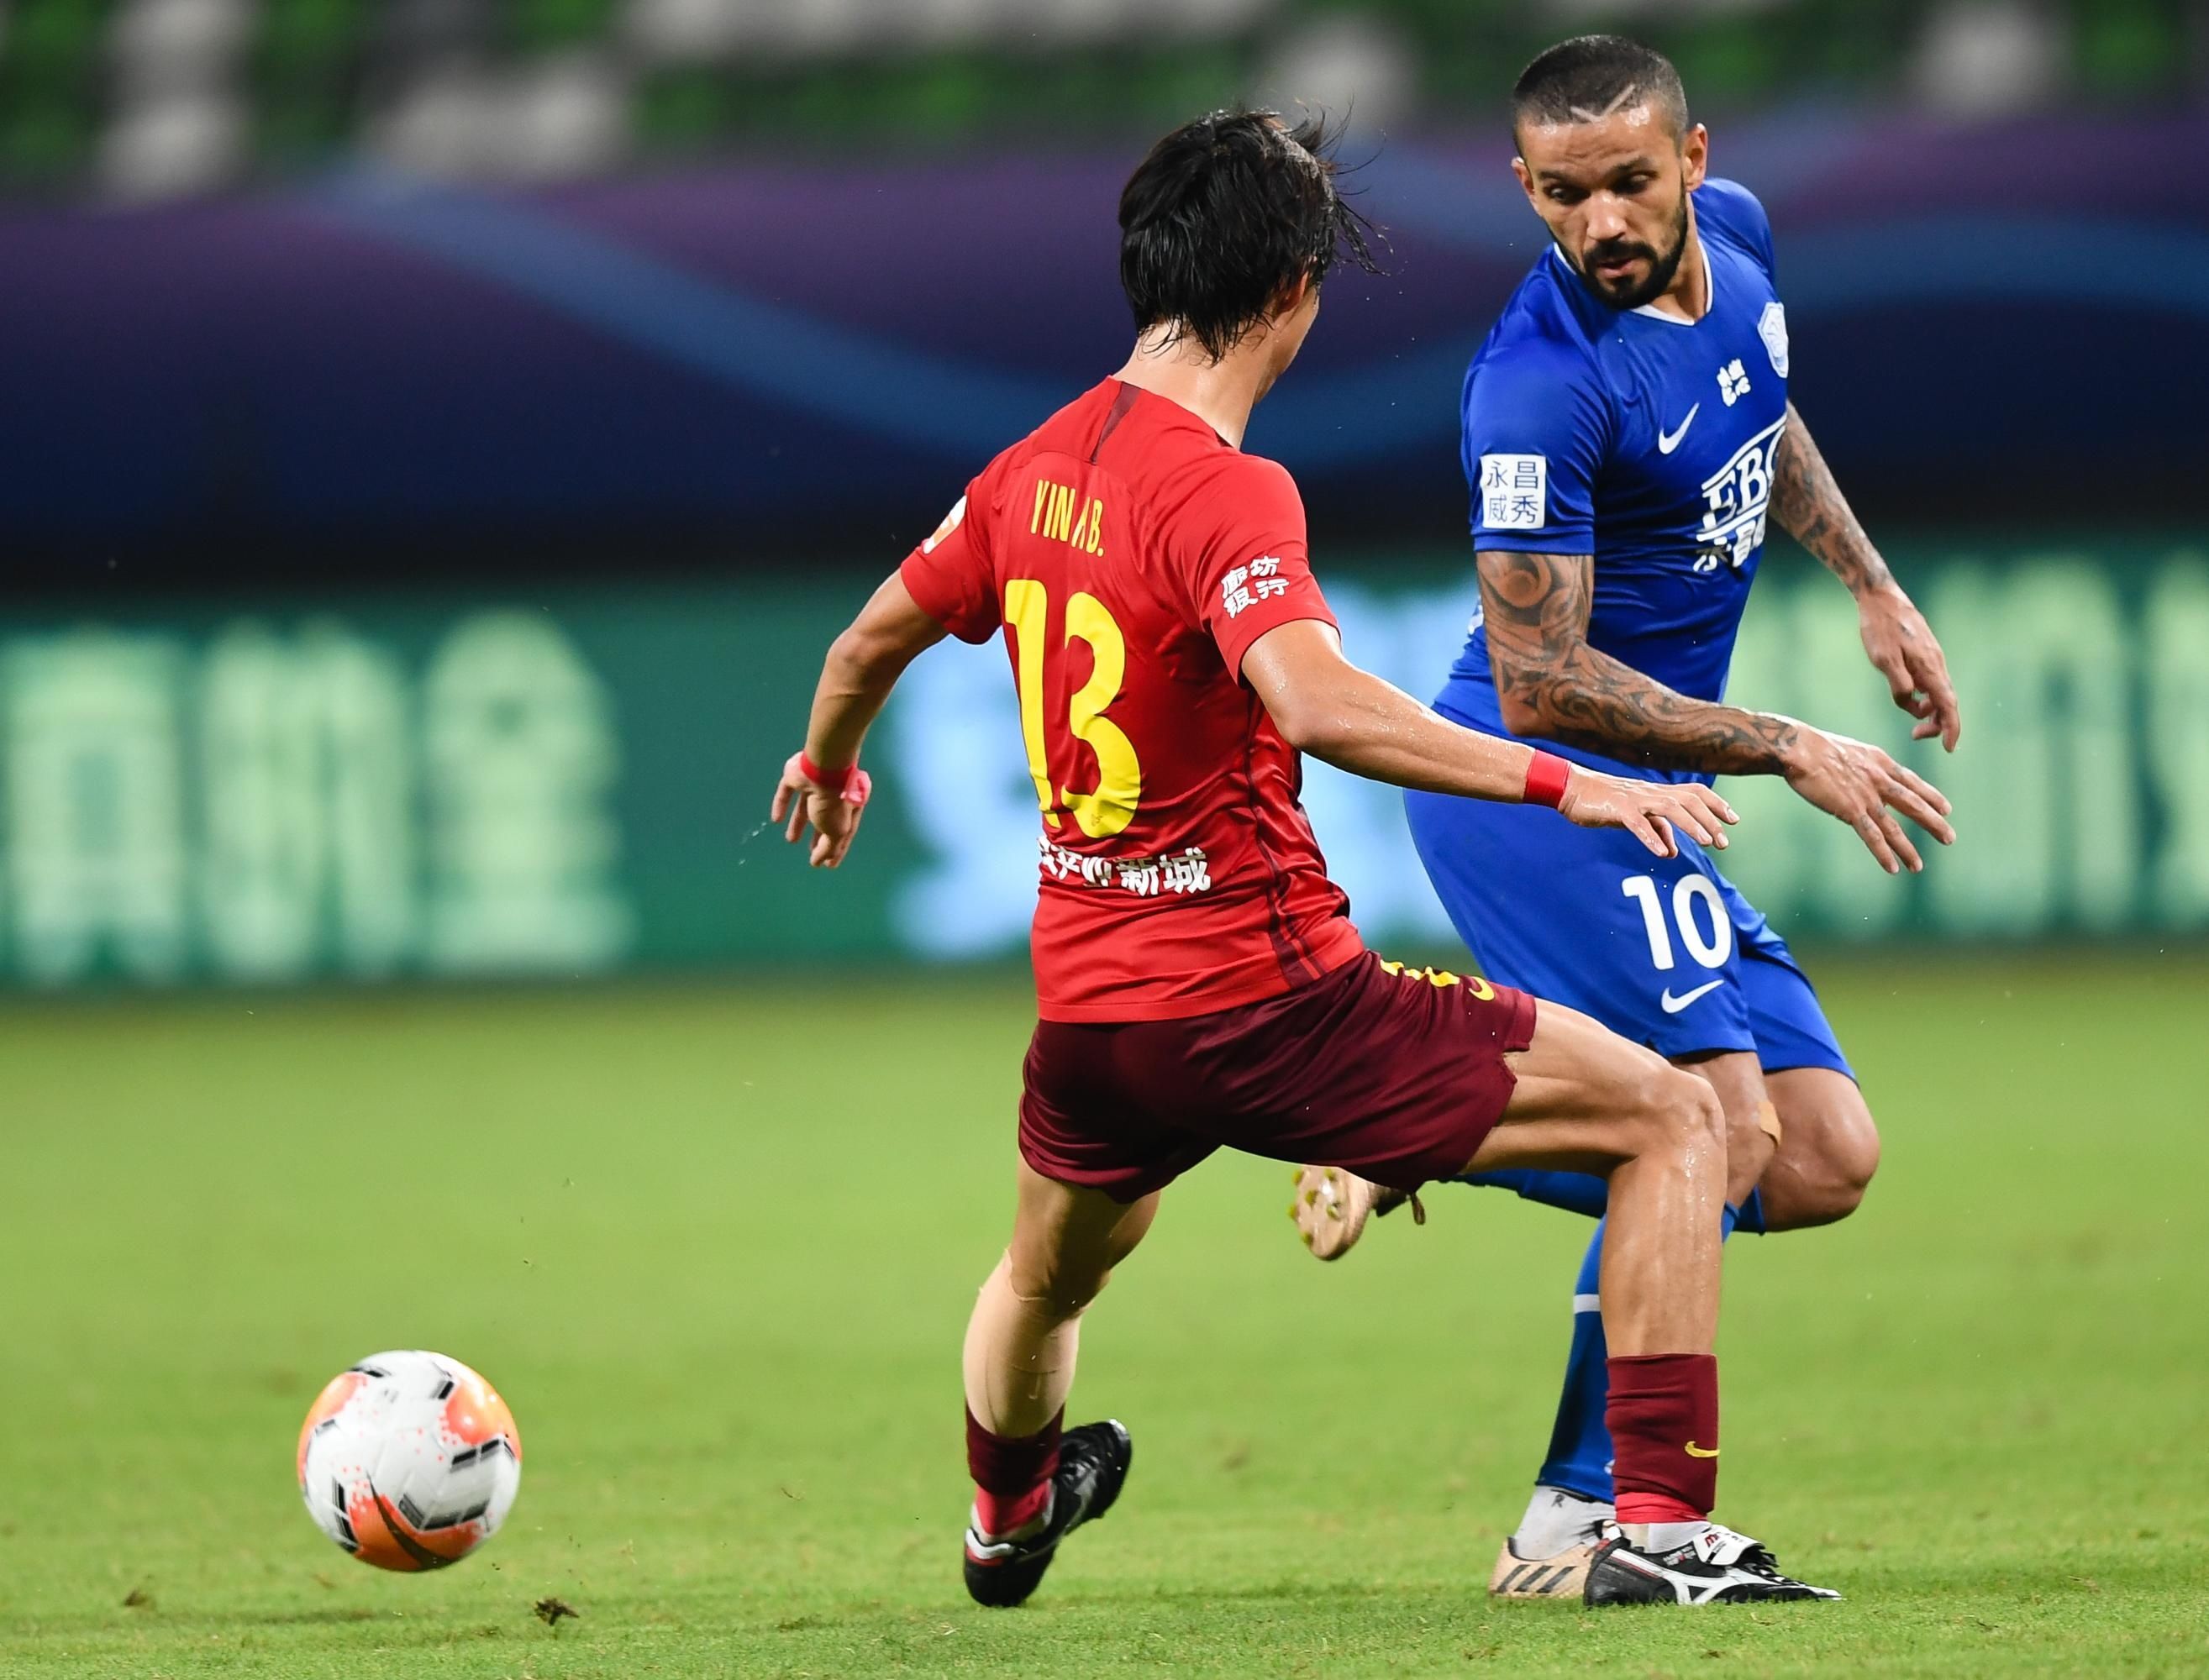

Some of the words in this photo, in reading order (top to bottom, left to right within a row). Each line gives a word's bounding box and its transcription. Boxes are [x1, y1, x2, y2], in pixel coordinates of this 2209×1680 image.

[1486, 460, 1538, 489] 永昌
[1030, 479, 1076, 543] YIN
[1488, 494, 1538, 524] 威秀
[1221, 555, 1281, 600] 廊坊
[1223, 578, 1290, 619] 银行
[1005, 578, 1141, 838] 13
[1622, 874, 1732, 970] 10
